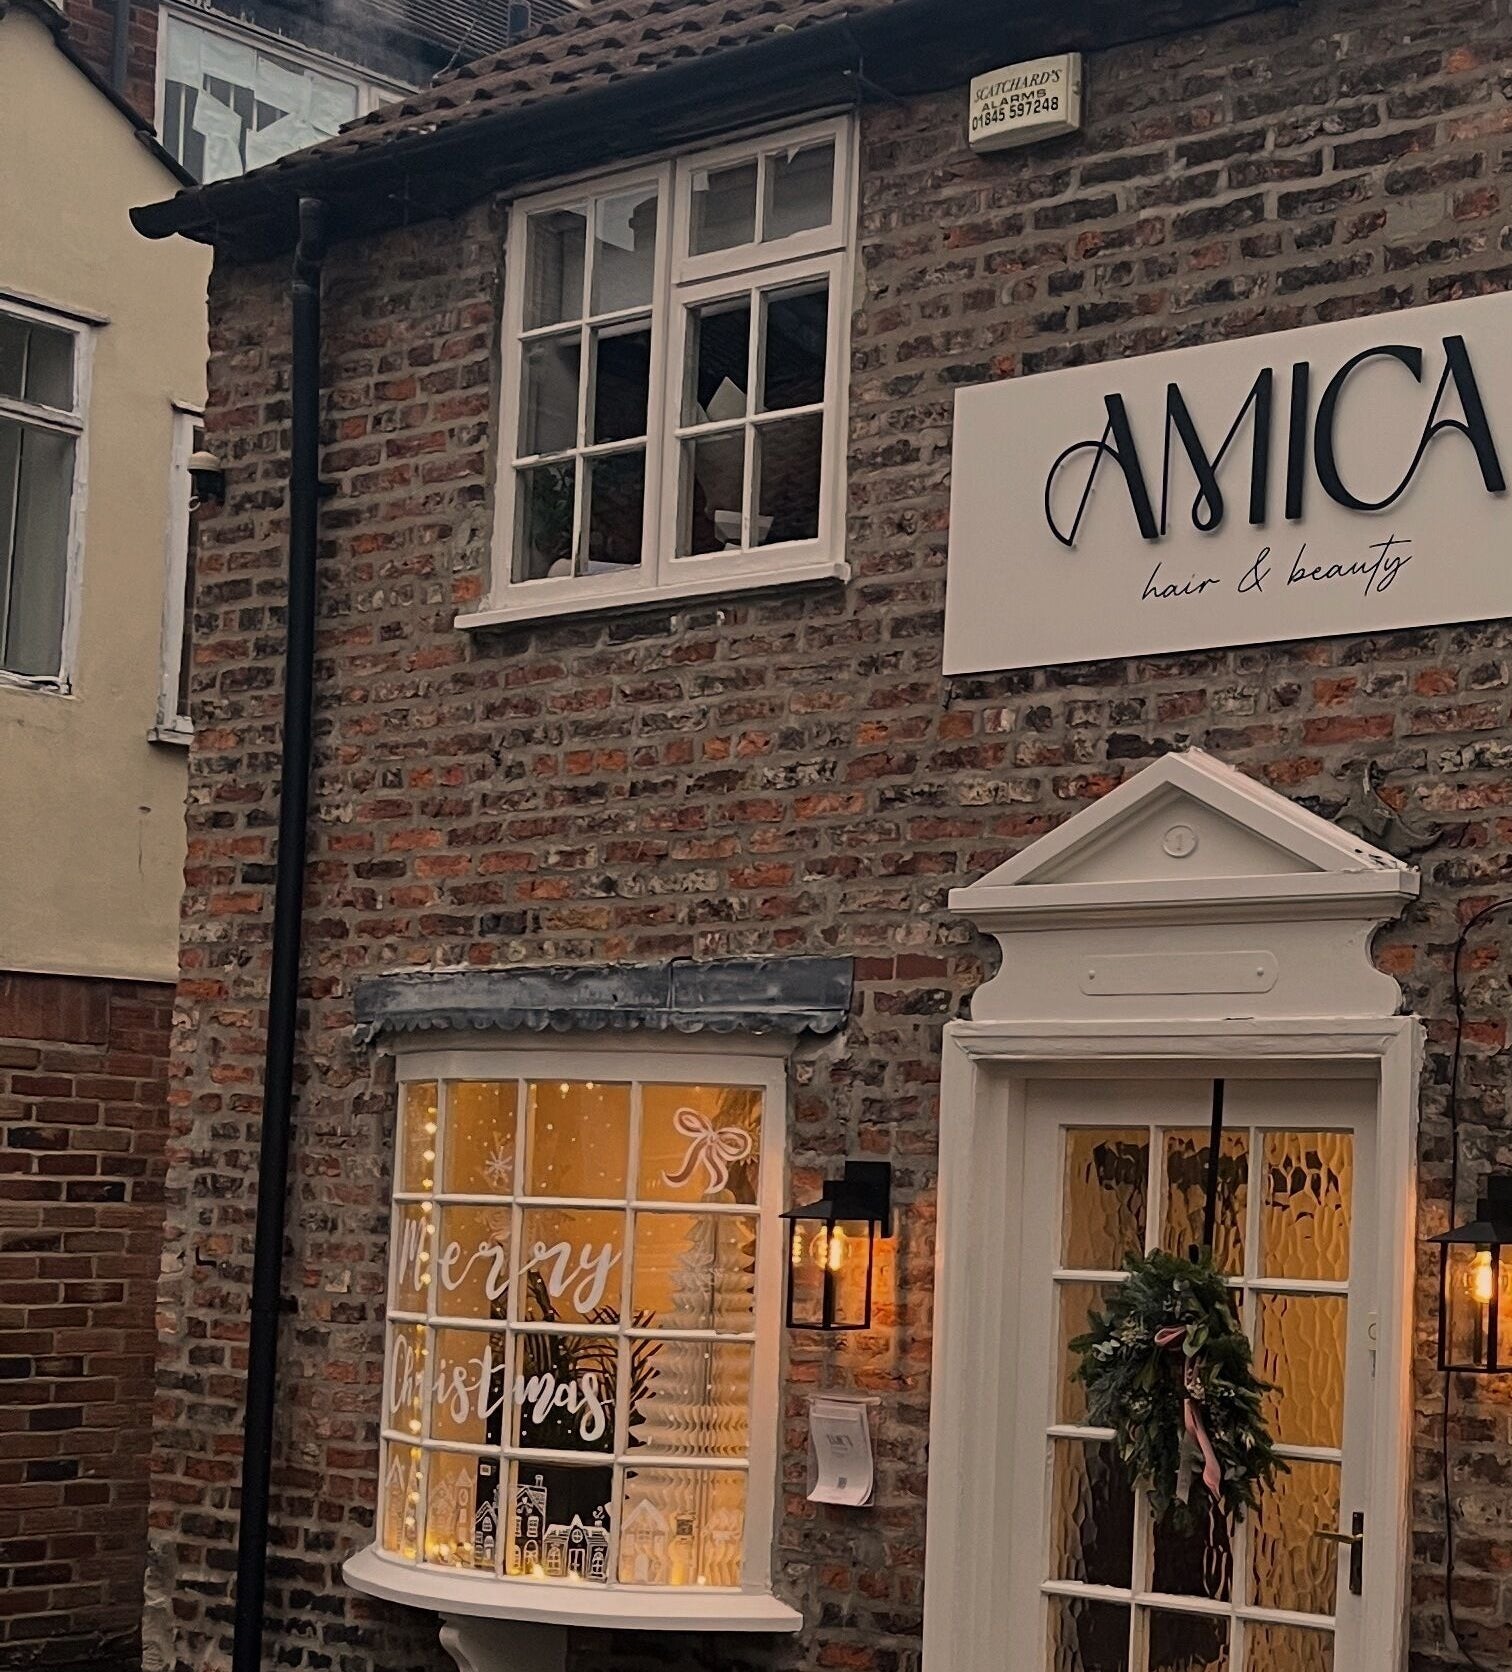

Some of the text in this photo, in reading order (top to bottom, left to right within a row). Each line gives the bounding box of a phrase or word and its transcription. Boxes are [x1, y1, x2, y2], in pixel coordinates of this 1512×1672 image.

[974, 69, 1062, 103] SCATCHARD'S
[982, 88, 1047, 112] ALARMS
[972, 96, 1059, 131] 01845 597248
[1044, 335, 1507, 547] AMICA
[1141, 534, 1414, 602] hair & beauty
[400, 1217, 622, 1314] Merry
